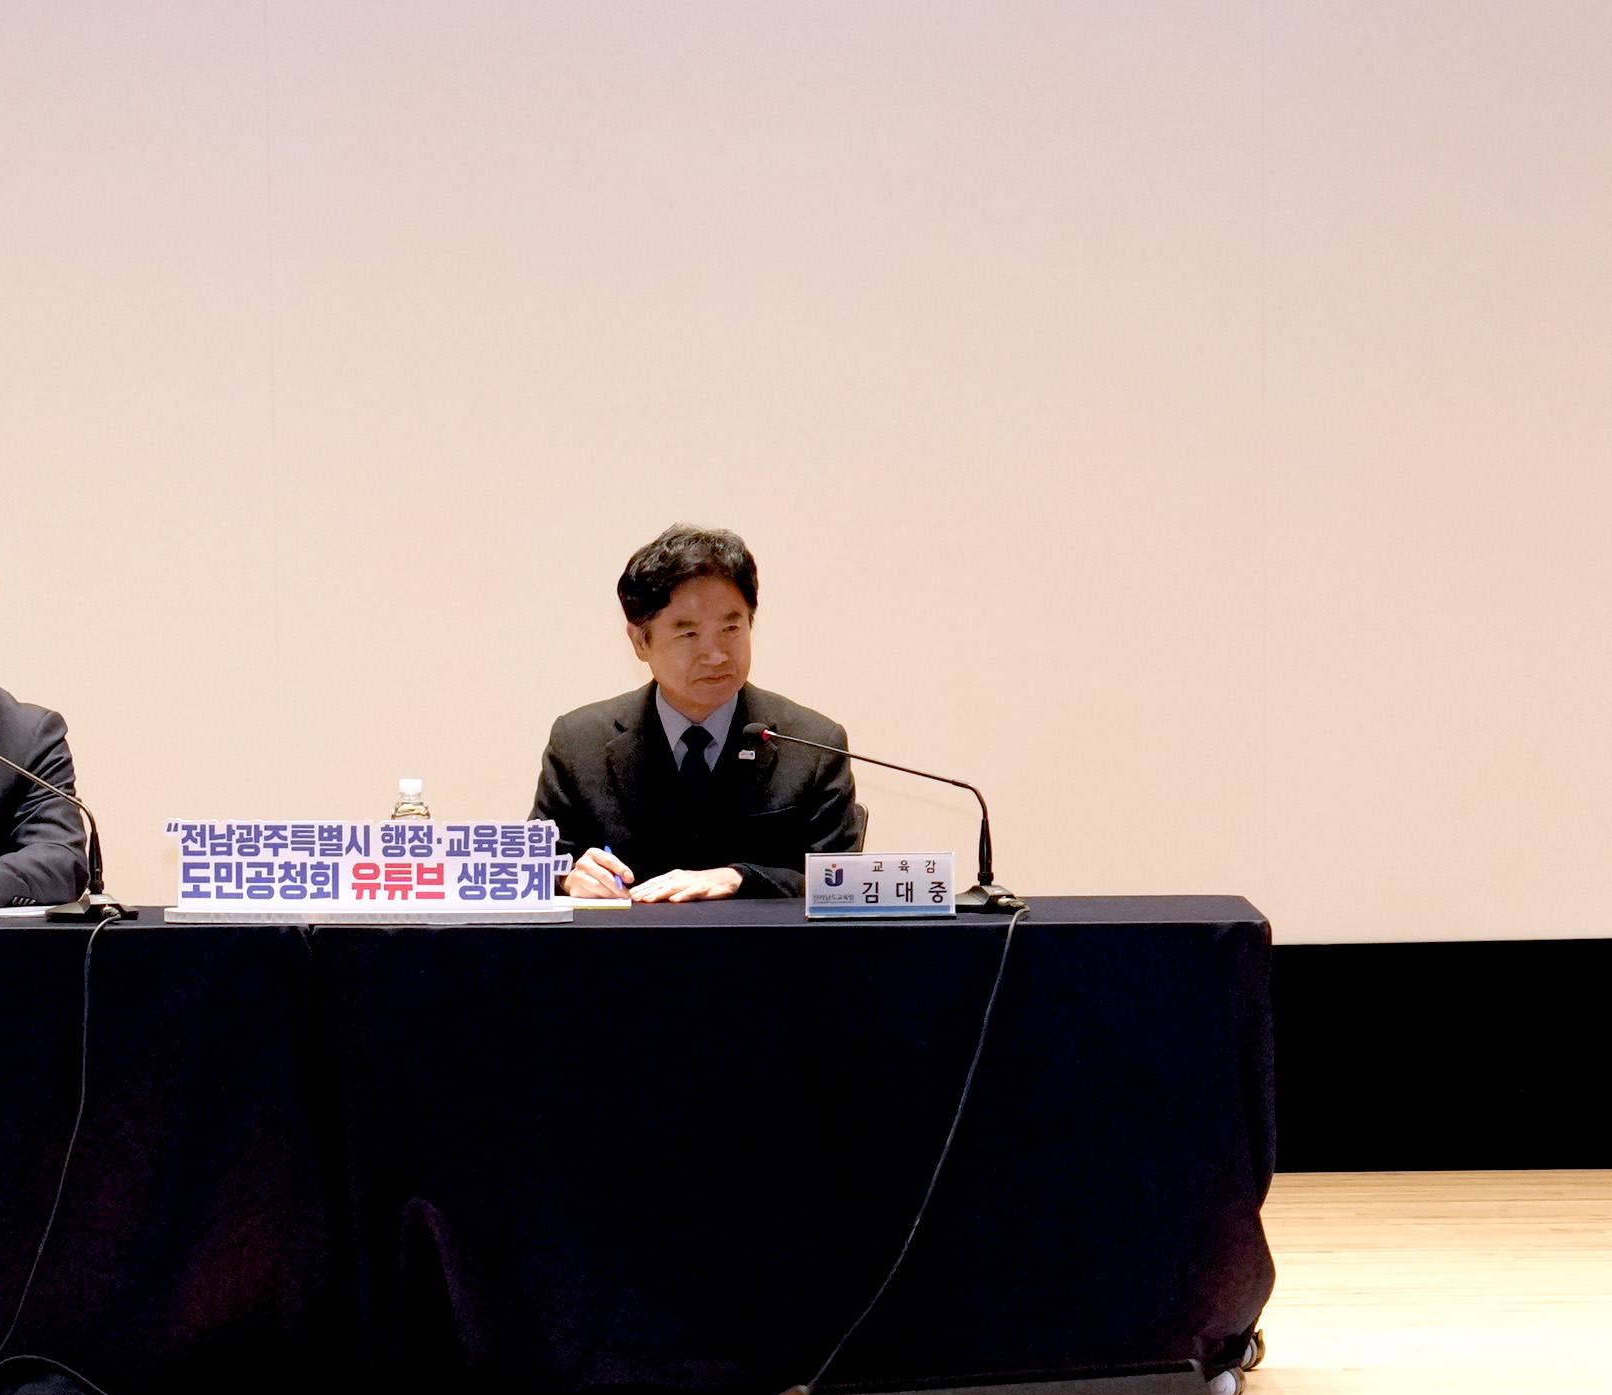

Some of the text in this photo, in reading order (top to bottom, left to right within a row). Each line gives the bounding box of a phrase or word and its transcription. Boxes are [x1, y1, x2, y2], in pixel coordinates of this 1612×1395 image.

[872, 860, 937, 874] 교육감
[181, 861, 340, 900] 도민공청회
[351, 862, 445, 900] 유튜브
[862, 881, 948, 903] 김대중
